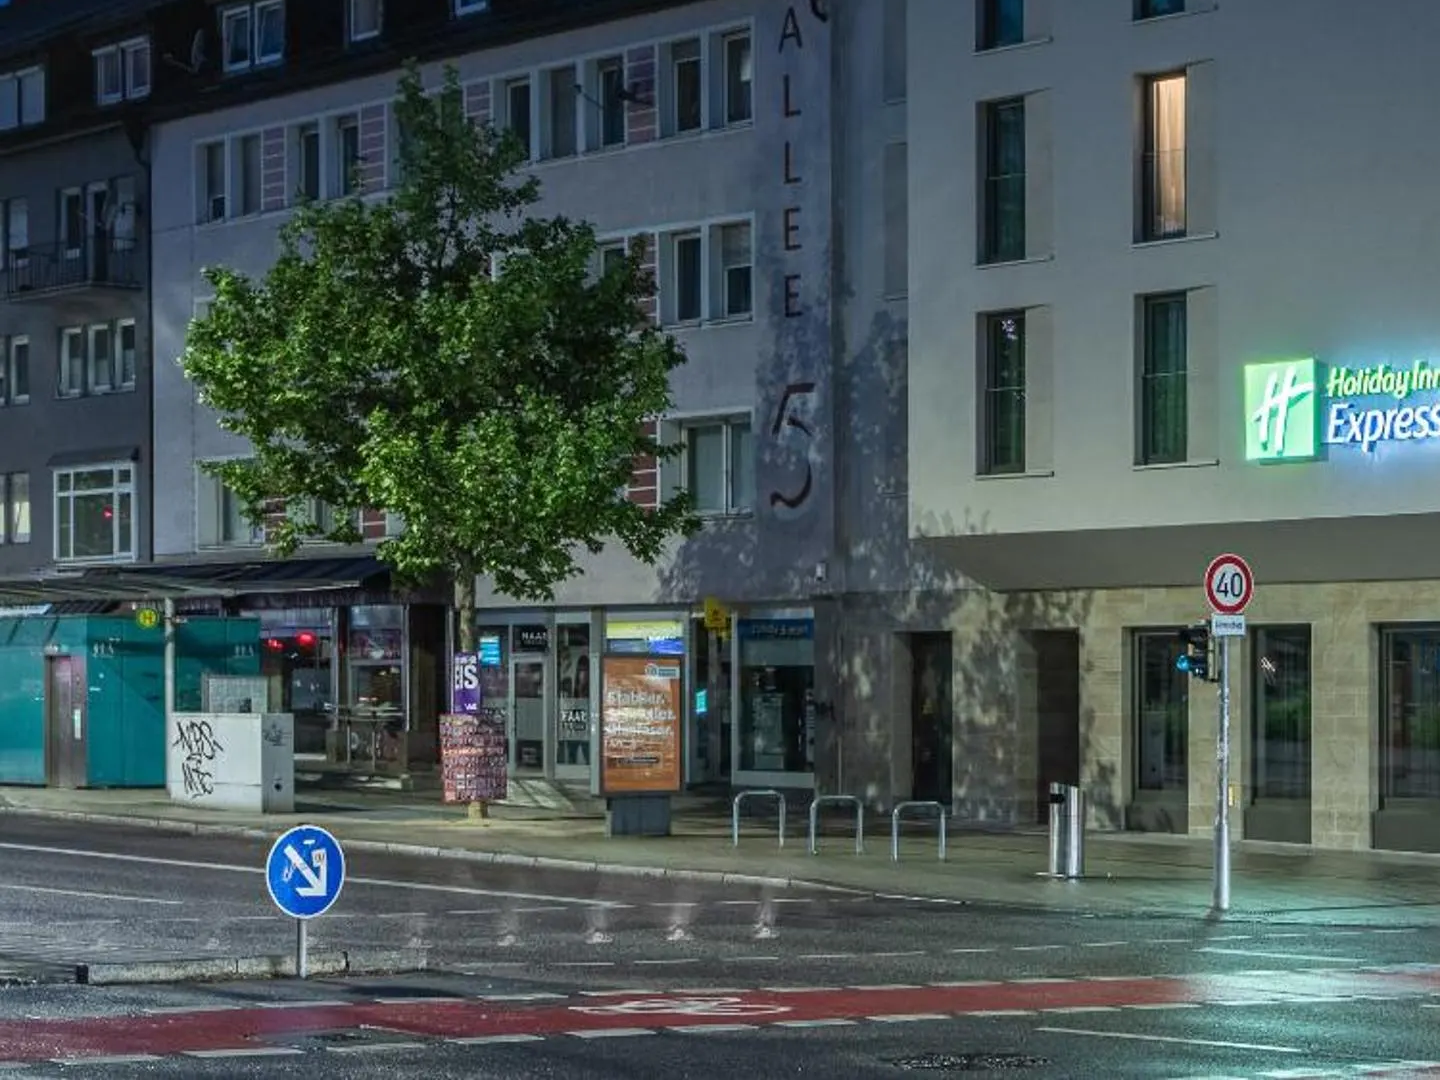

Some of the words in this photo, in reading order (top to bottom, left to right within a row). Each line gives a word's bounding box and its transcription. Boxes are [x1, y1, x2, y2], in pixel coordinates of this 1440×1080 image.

[777, 6, 803, 318] ALLEE
[1326, 364, 1409, 399] Holiday
[1216, 572, 1243, 597] 40
